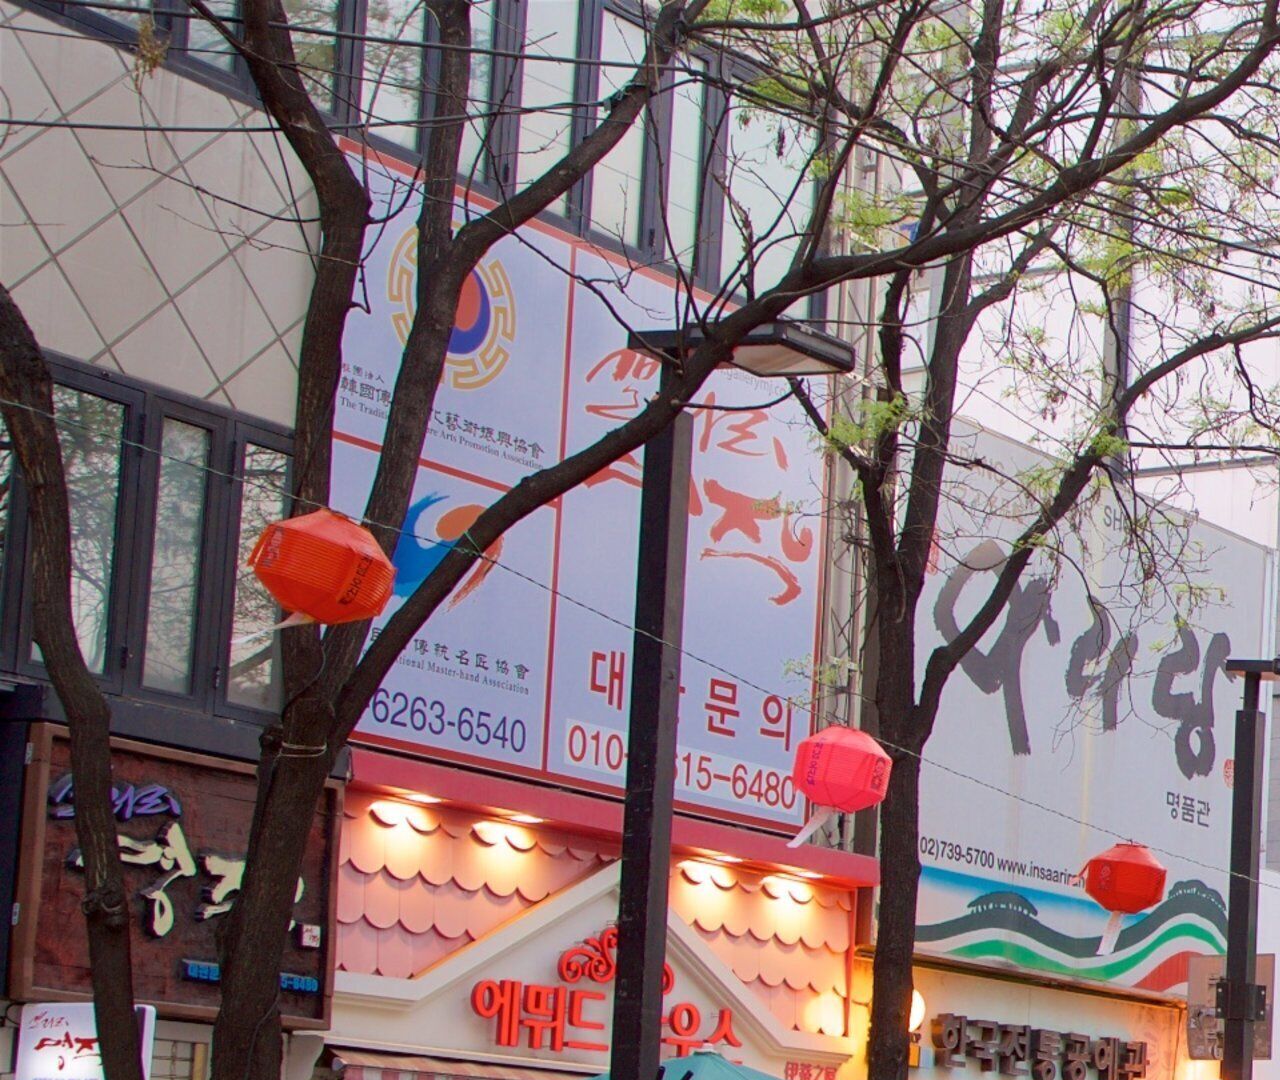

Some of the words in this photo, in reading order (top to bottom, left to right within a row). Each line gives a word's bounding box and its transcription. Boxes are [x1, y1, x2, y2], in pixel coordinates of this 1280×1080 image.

[482, 675, 530, 696] Association
[372, 688, 527, 753] 6263-6540
[1165, 791, 1212, 828] 명품관
[470, 977, 744, 1067] 에뛰드우스
